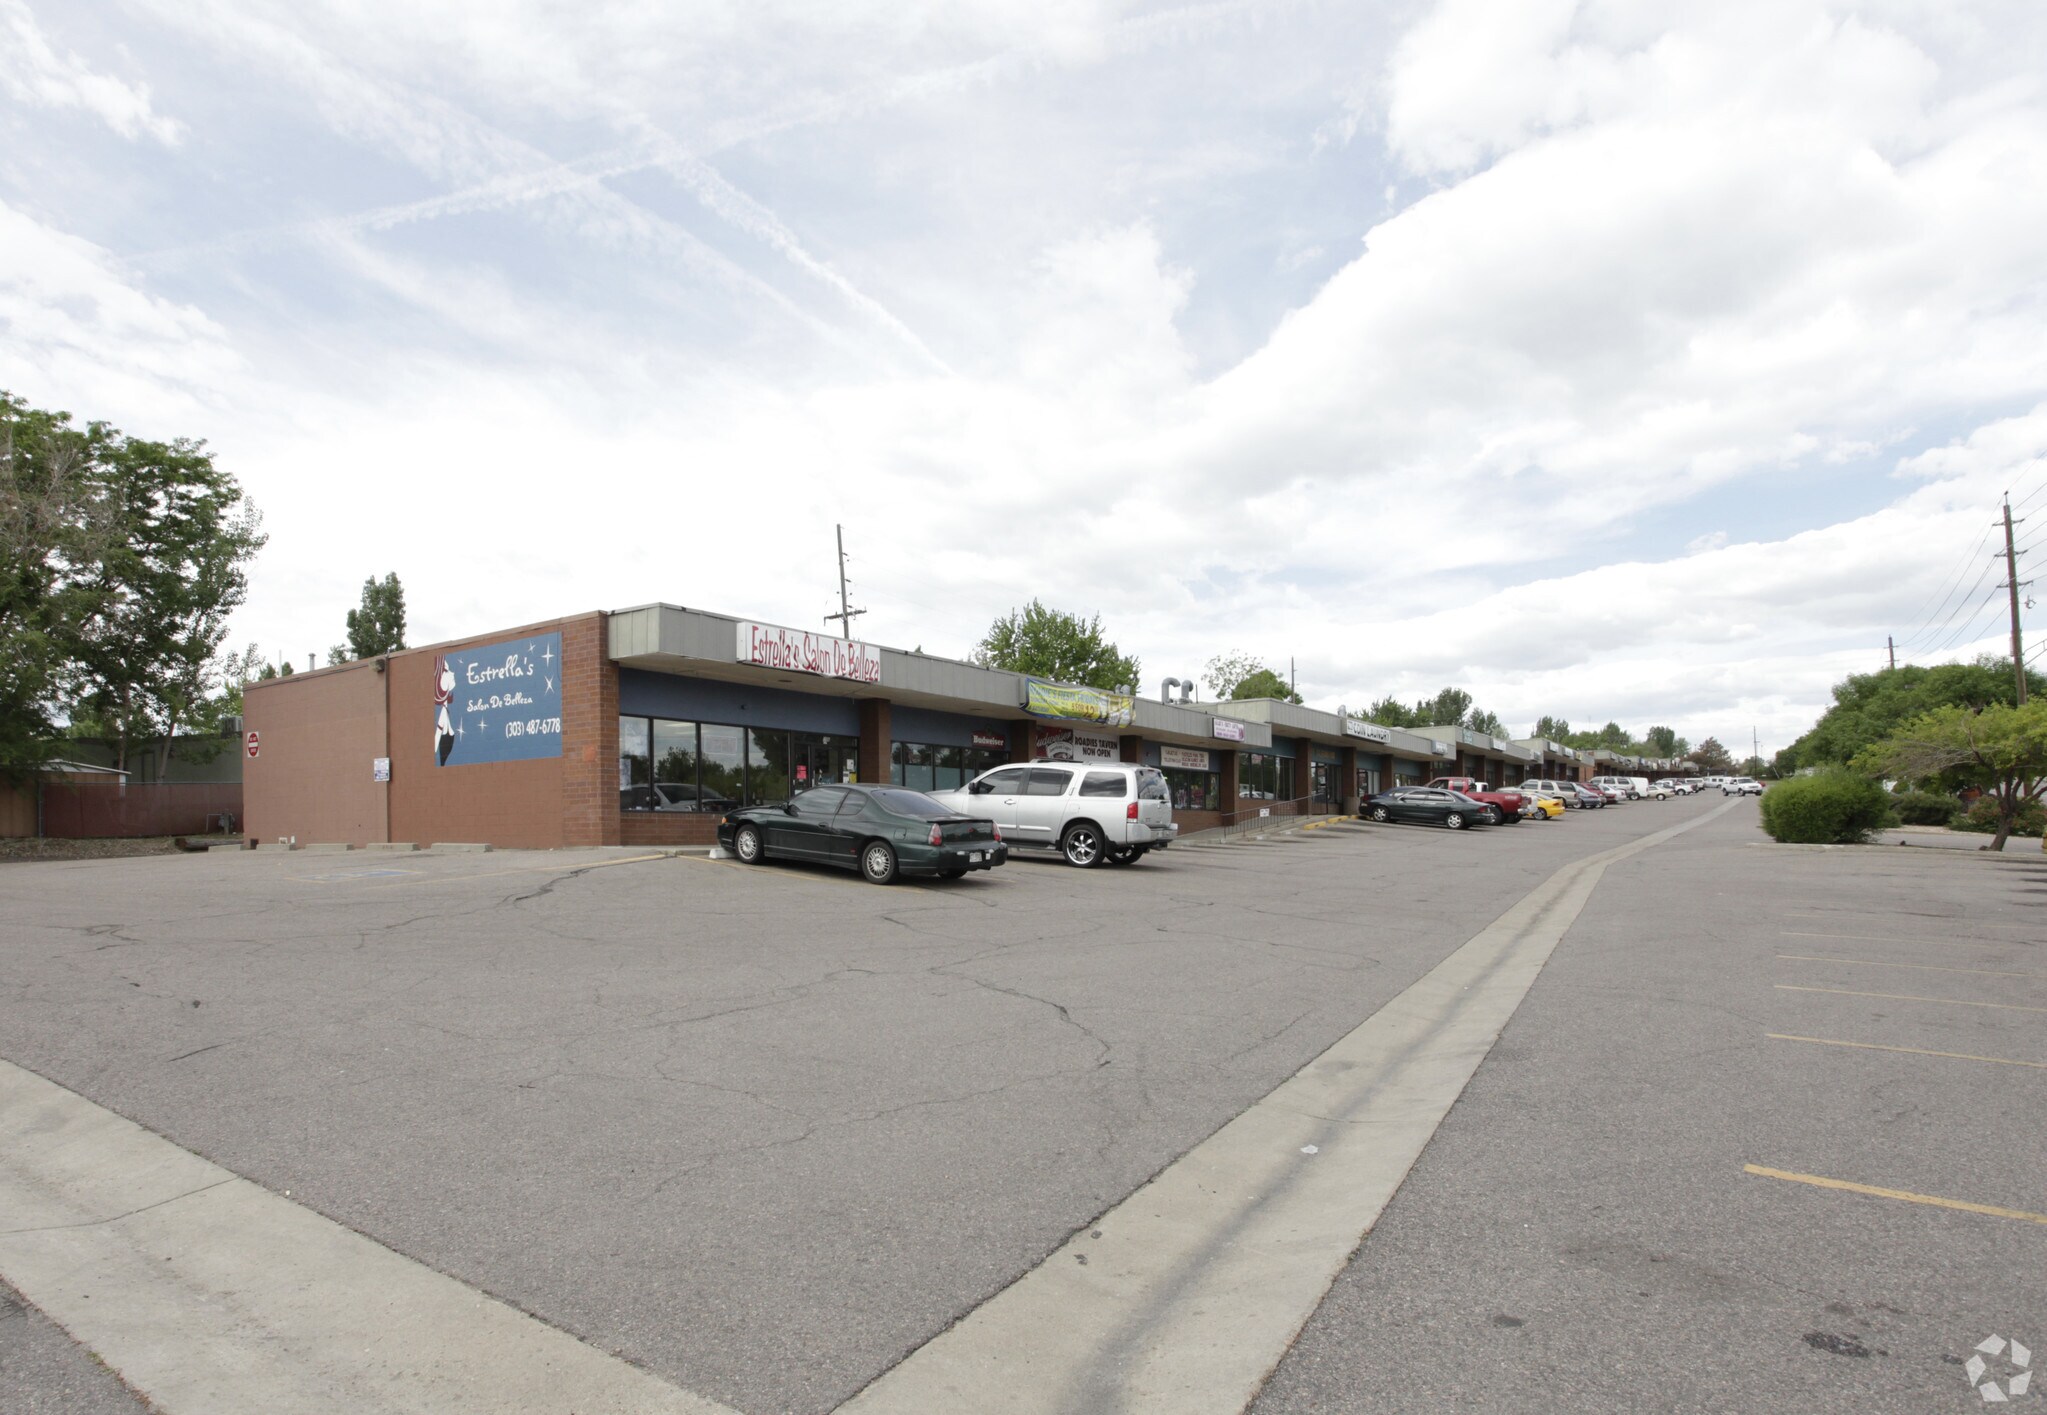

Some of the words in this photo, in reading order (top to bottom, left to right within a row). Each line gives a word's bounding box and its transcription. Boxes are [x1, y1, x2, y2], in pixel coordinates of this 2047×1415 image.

[752, 625, 799, 668] Estrella's
[802, 633, 831, 673] Salon
[834, 639, 846, 676] De
[848, 642, 879, 681] Belleza
[466, 654, 534, 684] Estrella's
[466, 698, 490, 712] Salon
[490, 695, 503, 708] De
[503, 691, 533, 706] Belleza
[505, 720, 525, 739] (303)
[526, 717, 561, 735] 487-6778
[973, 734, 1004, 746] Budweiser
[1075, 736, 1099, 748] ROADIES
[1100, 740, 1118, 750] TAVERN
[1082, 747, 1096, 756] NOW
[1097, 749, 1111, 758] OPEN
